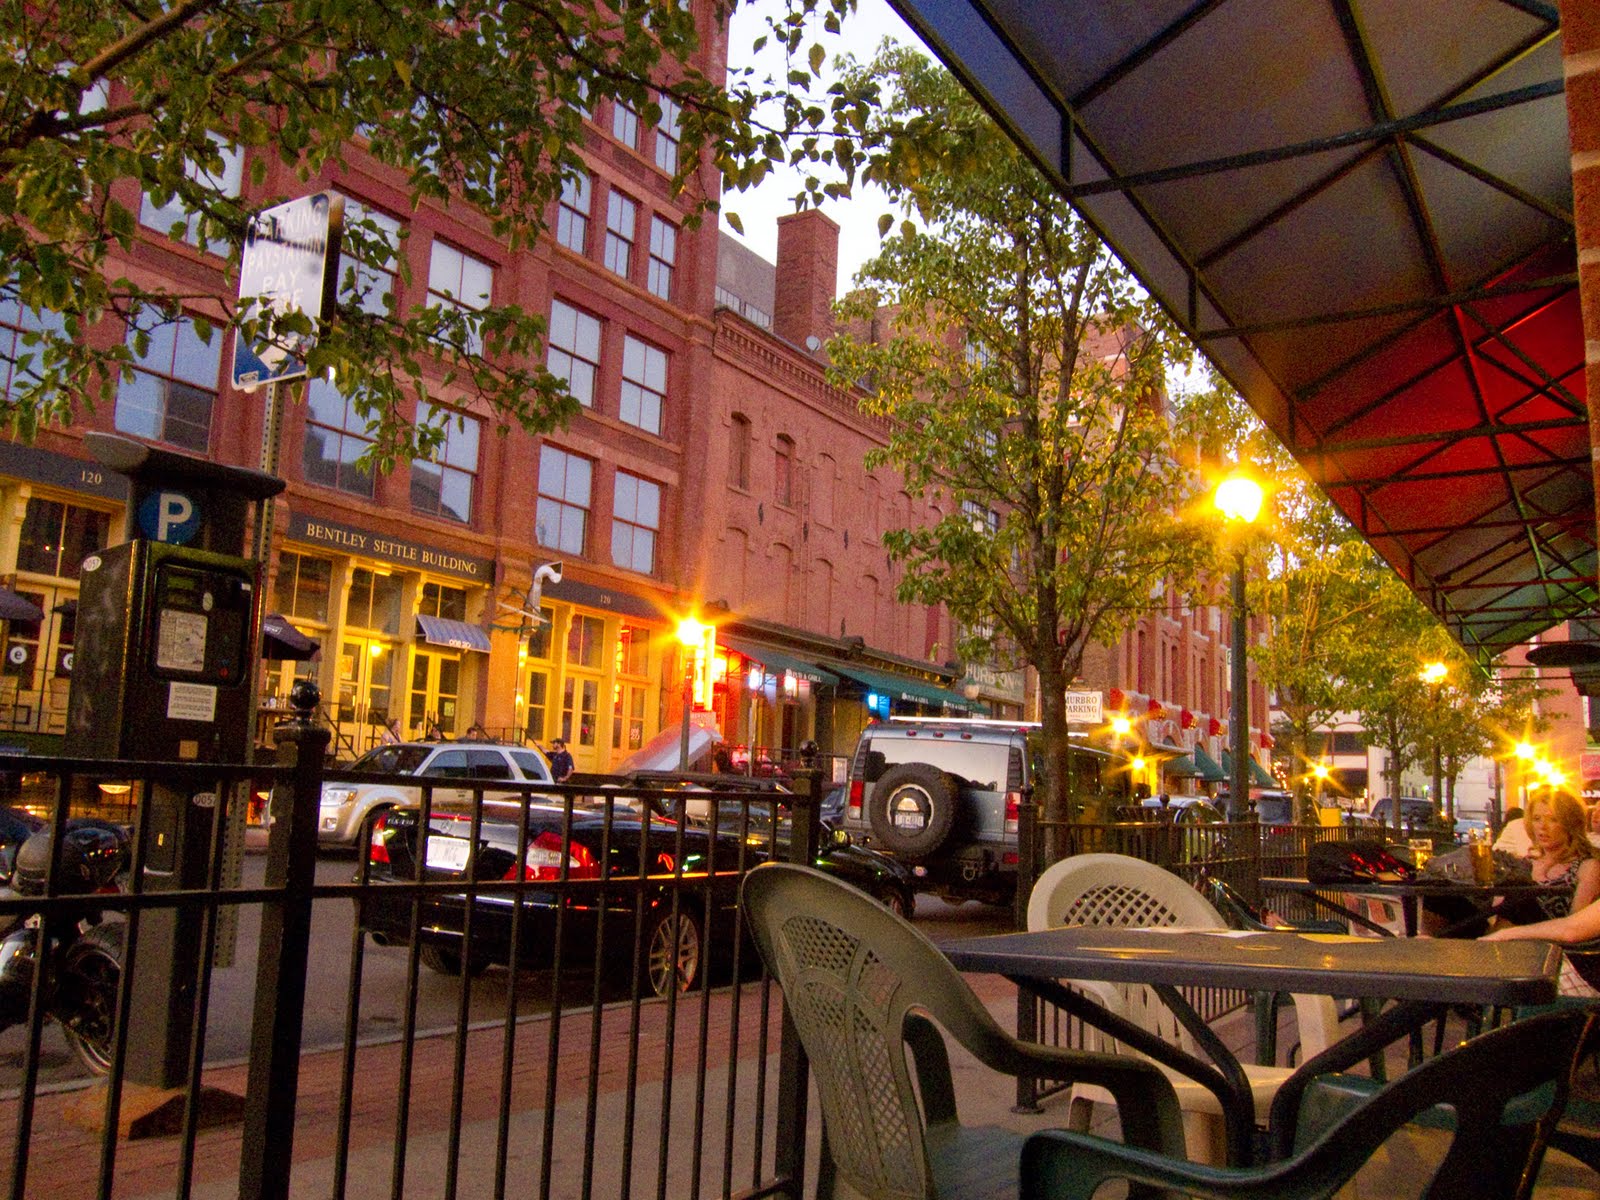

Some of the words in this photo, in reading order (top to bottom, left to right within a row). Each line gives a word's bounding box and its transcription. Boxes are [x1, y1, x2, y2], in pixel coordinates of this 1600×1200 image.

[262, 267, 301, 293] PAY
[81, 470, 102, 485] 120
[157, 492, 193, 541] P
[307, 523, 367, 548] BENTLEY
[373, 539, 417, 561] SETTLE
[422, 551, 477, 575] BUILDING
